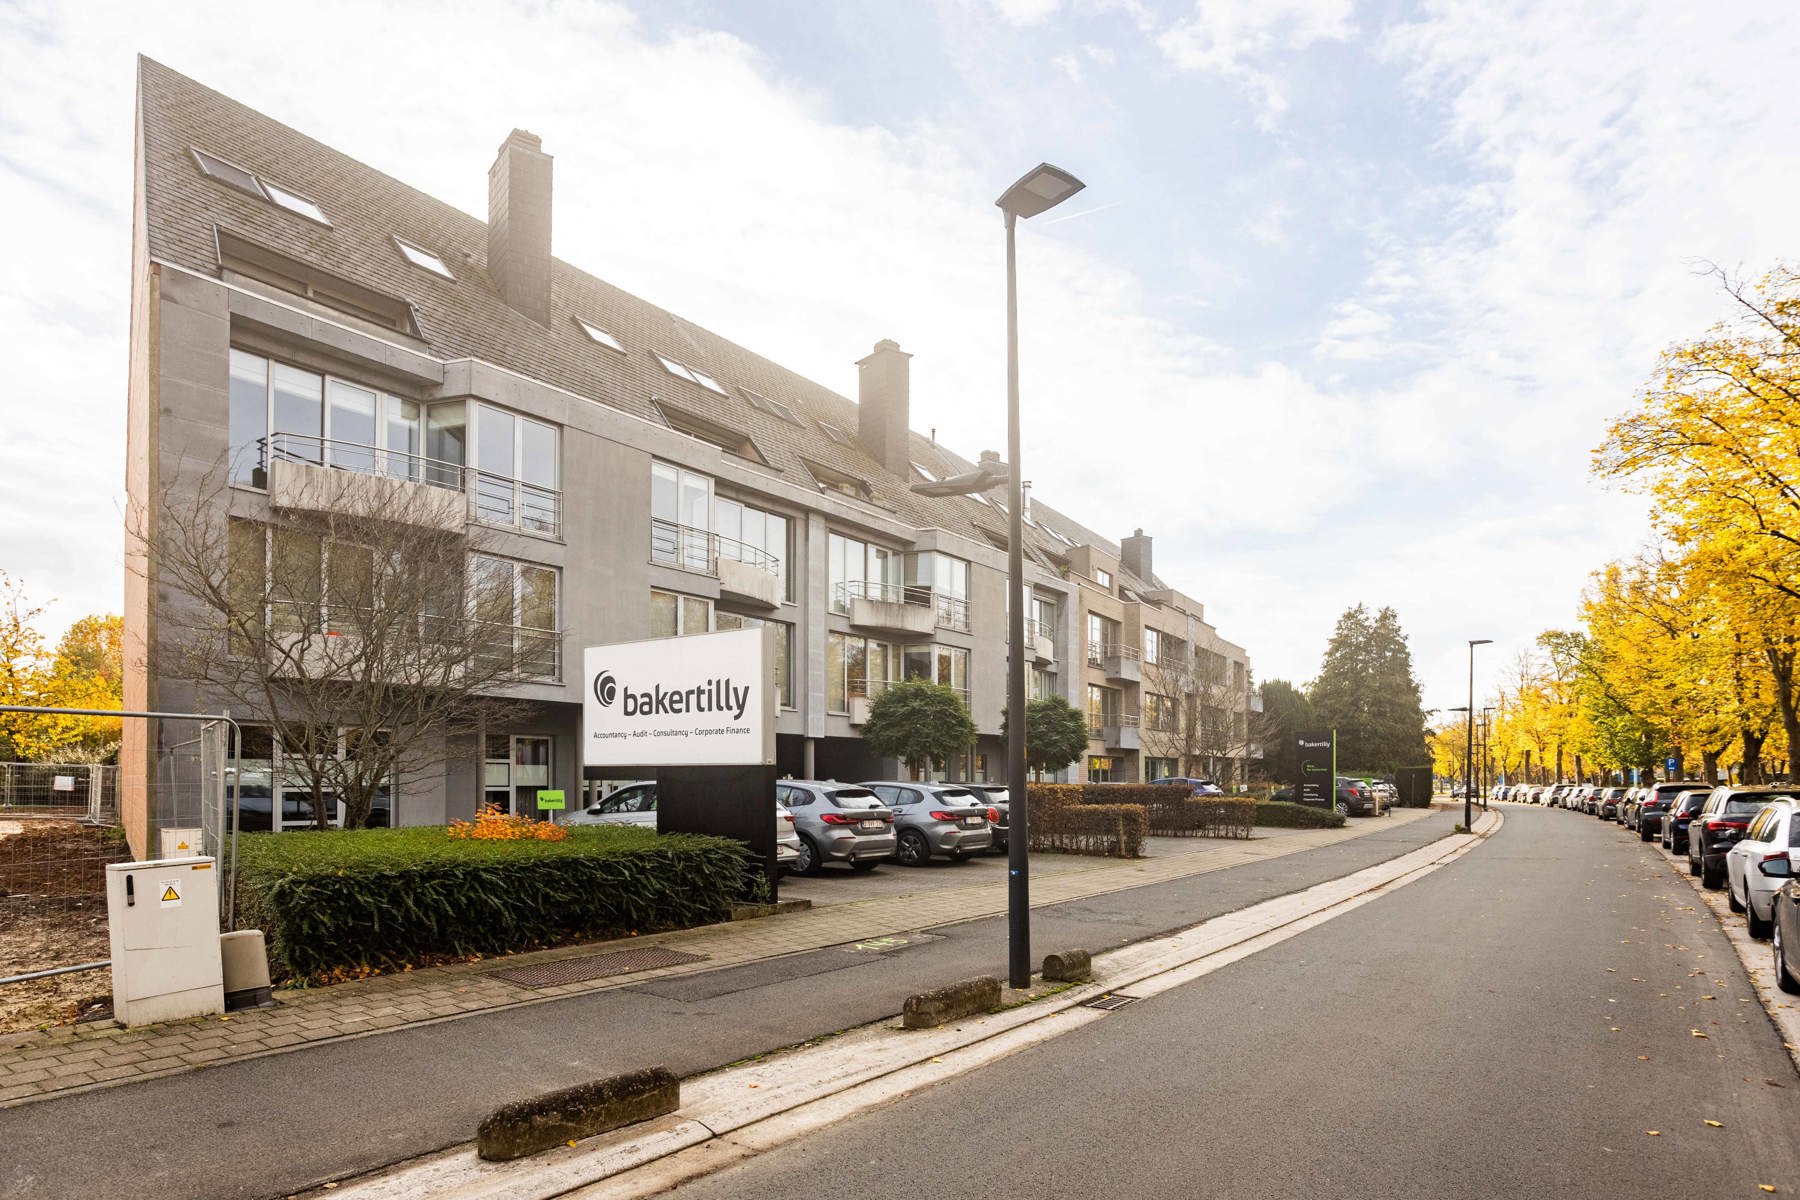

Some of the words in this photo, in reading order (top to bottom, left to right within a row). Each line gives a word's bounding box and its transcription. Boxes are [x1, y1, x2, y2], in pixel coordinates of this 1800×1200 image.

[623, 678, 750, 720] bakertilly
[593, 731, 627, 740] Accountancy
[632, 730, 648, 738] Audit
[653, 728, 689, 738] Consultancy
[694, 727, 725, 736] Corporate
[726, 726, 750, 735] Finance
